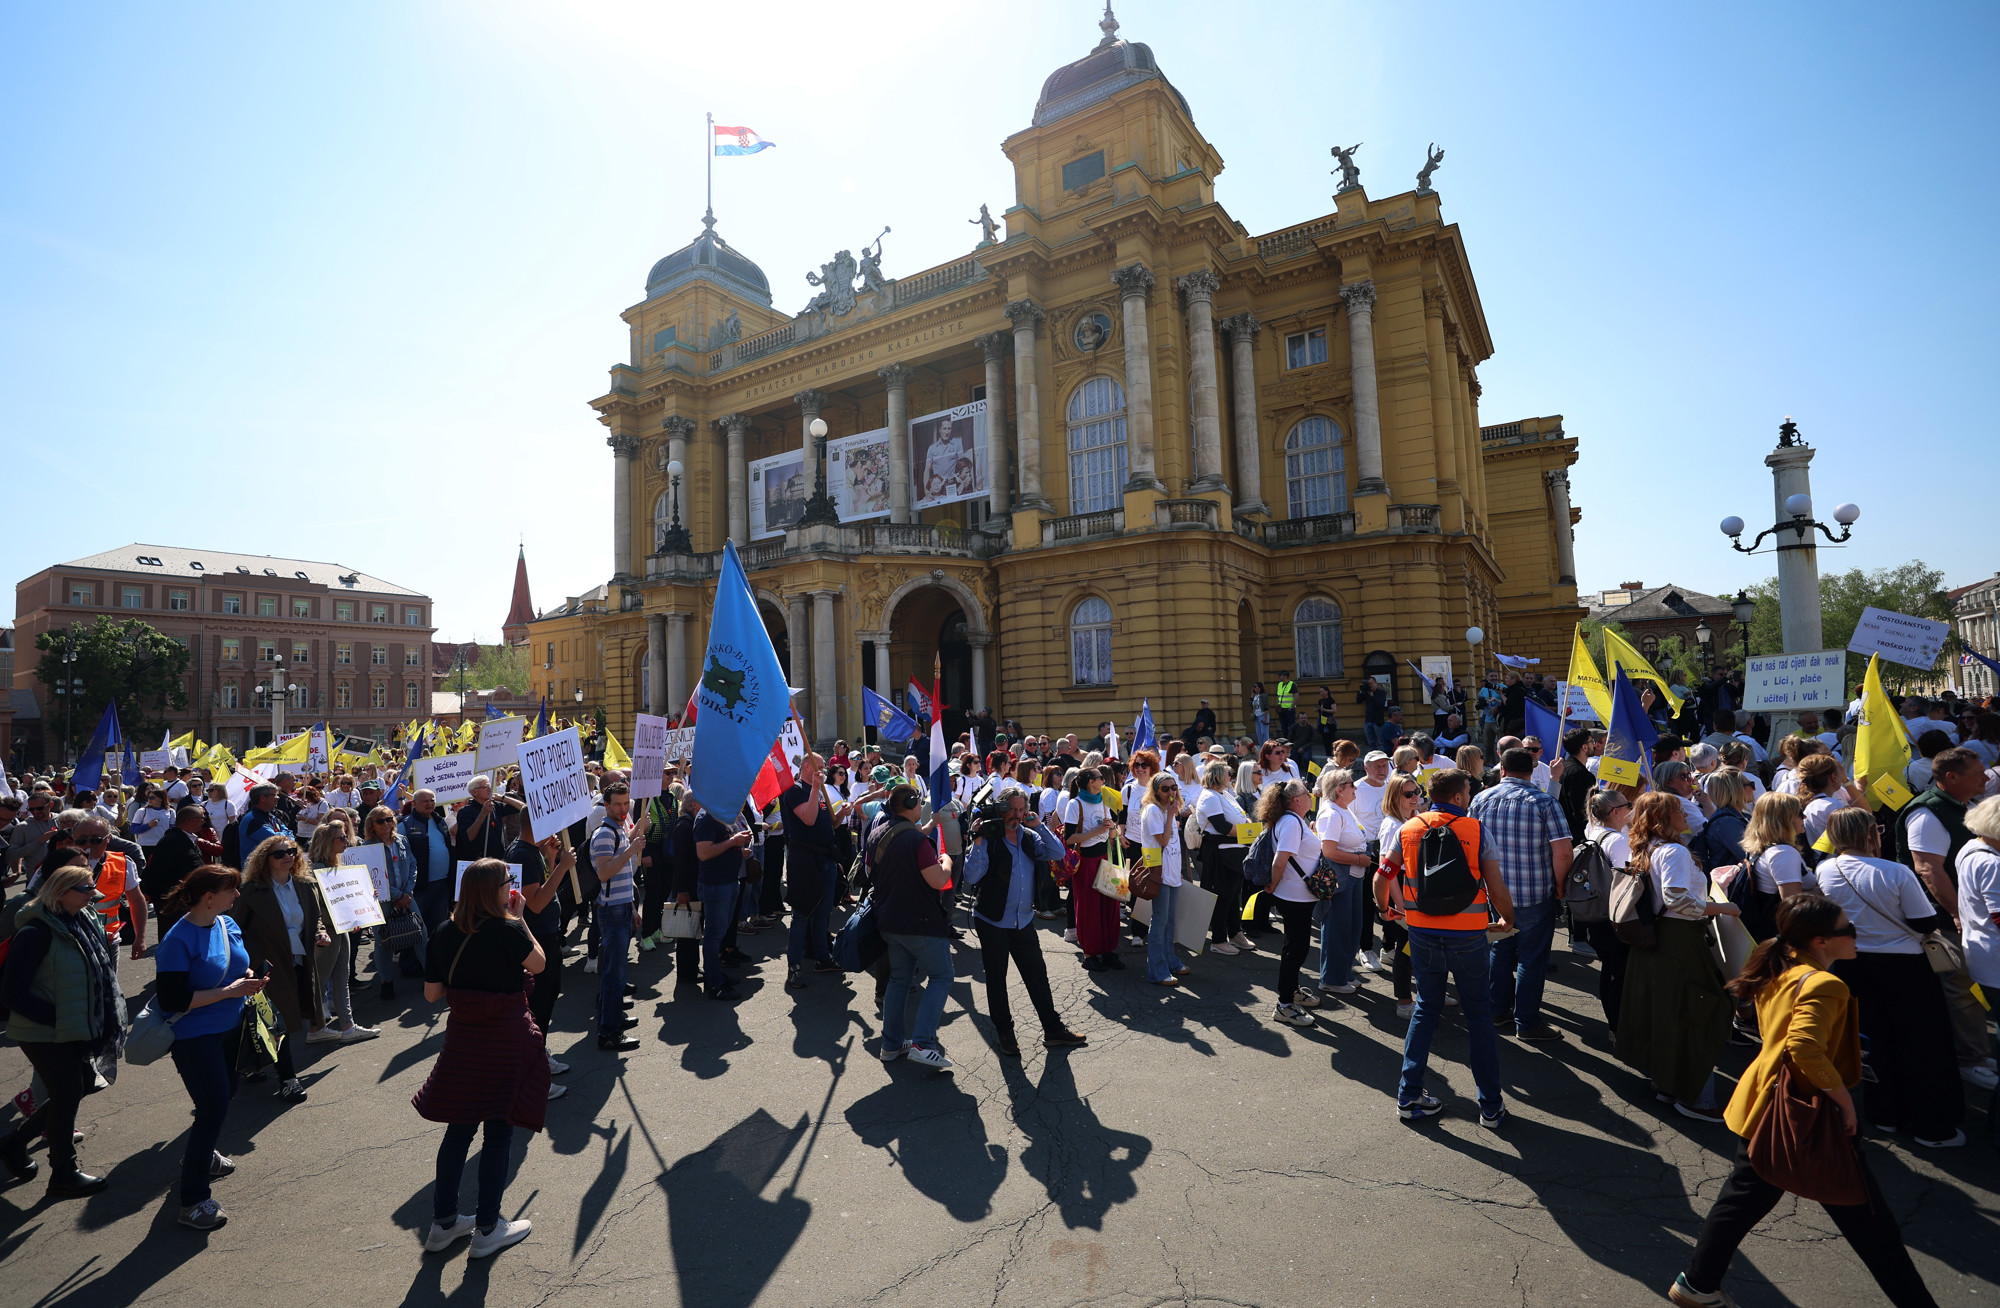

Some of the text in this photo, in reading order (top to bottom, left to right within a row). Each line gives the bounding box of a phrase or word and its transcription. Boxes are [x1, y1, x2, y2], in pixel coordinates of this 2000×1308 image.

[746, 321, 964, 398] HRVATSKO NARODNO KAZALIŠTE
[952, 401, 988, 419] SORRY
[1863, 622, 1880, 630] NEMA
[1876, 615, 1931, 631] DOSTOJANSTVO
[1750, 653, 1840, 672] Kad naš rad cijeni đak neuk
[1577, 674, 1602, 684] MATICA
[1800, 673, 1822, 686] plače
[1756, 695, 1760, 703] i
[1763, 693, 1789, 704] učitelj
[1793, 691, 1796, 701] i
[1802, 689, 1819, 701] vuk
[700, 694, 748, 725] DIKAT
[787, 735, 798, 747] NA
[526, 738, 576, 783] STOP POREZU
[528, 789, 545, 821] NA
[542, 767, 588, 815] SIROMAŠTVO
[1379, 862, 1392, 874] AR
